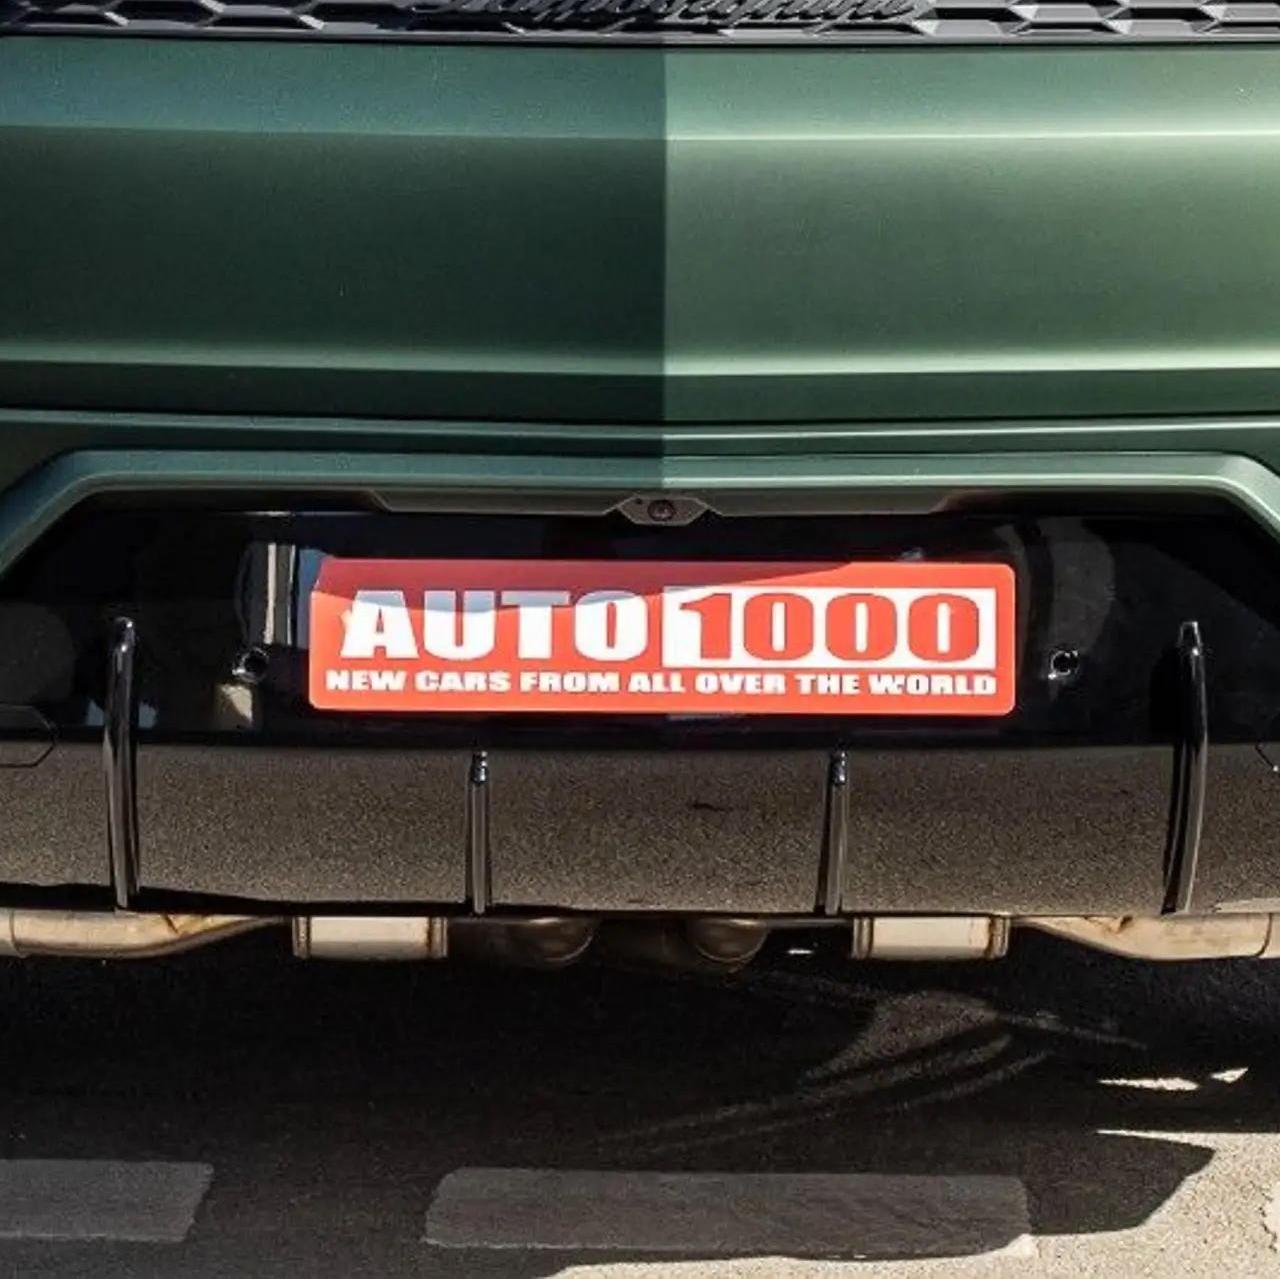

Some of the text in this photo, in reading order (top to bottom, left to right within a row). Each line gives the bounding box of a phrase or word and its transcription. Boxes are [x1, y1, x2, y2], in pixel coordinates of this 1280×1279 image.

[325, 669, 997, 696] NEW CARS FROM ALL OVER THE WORLD
